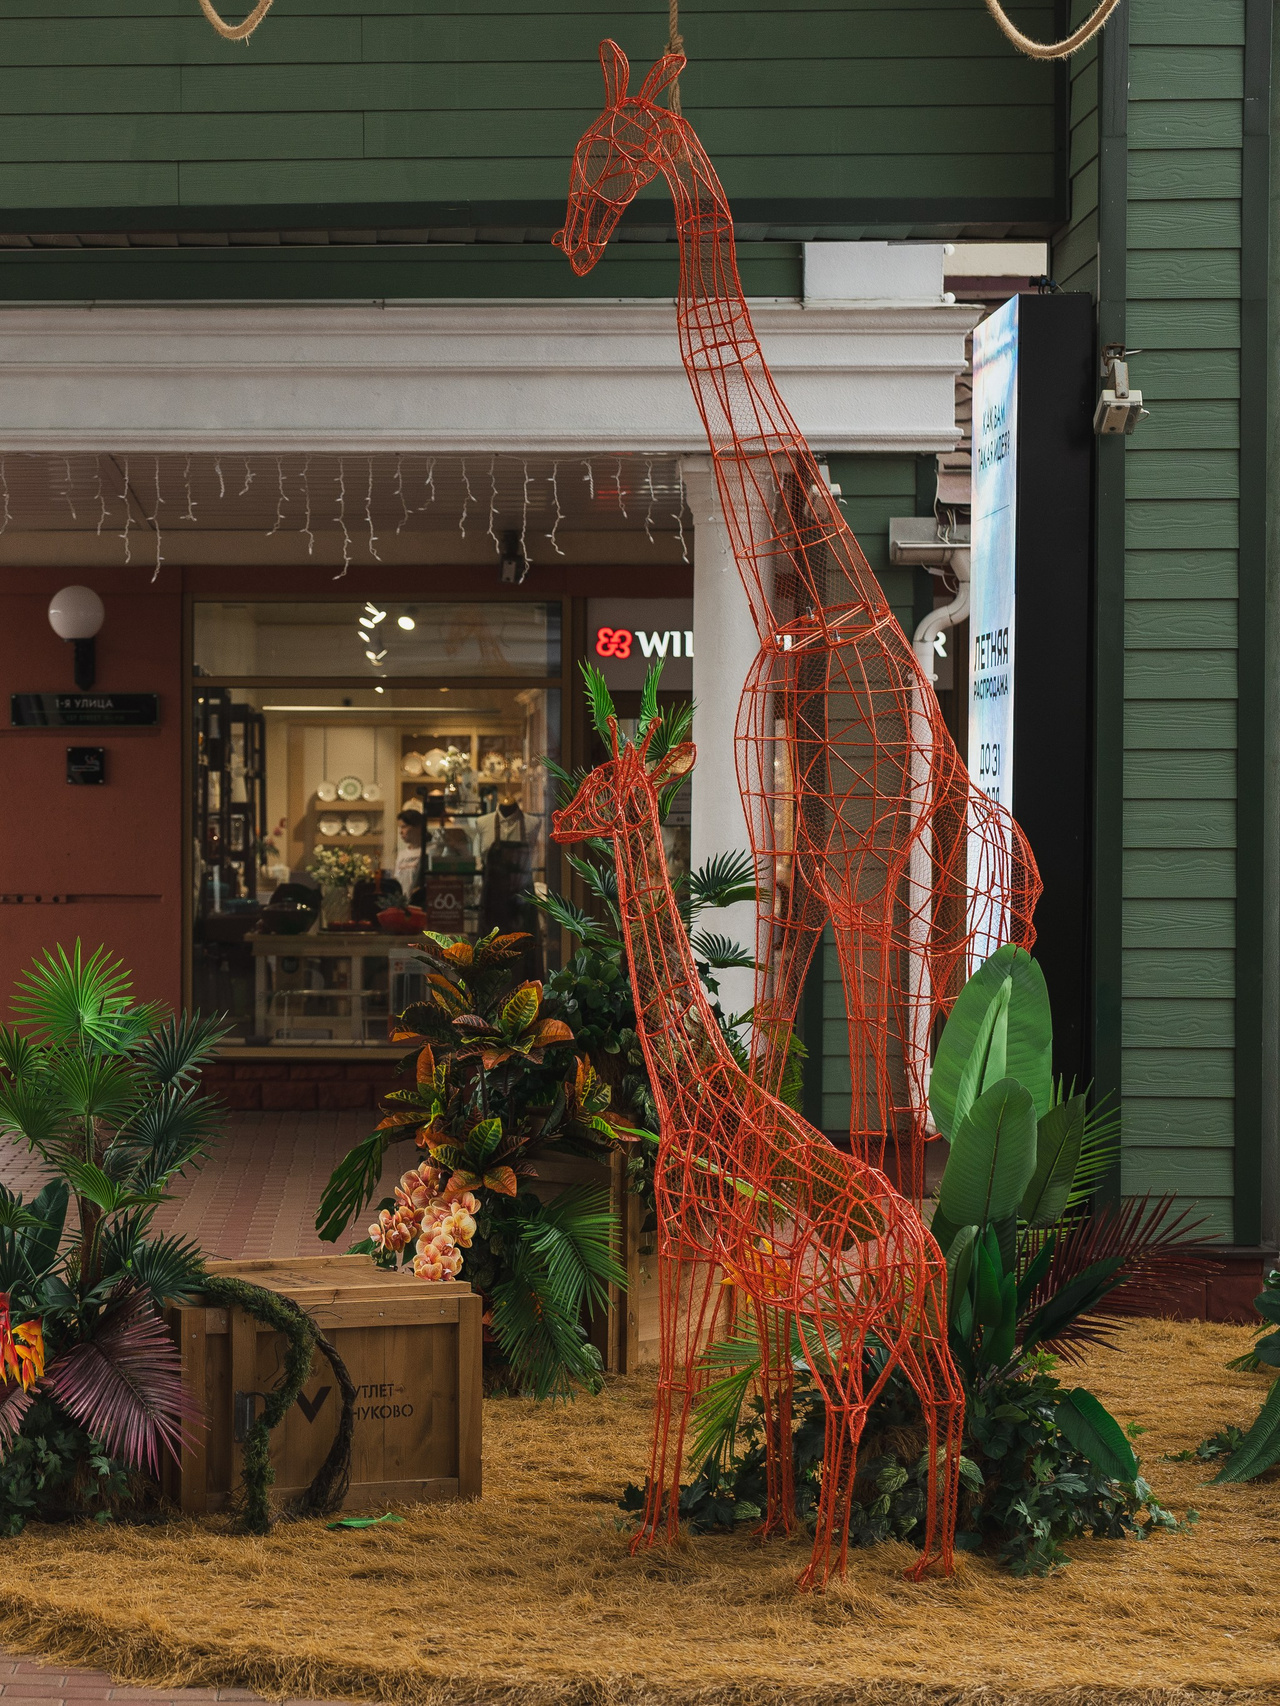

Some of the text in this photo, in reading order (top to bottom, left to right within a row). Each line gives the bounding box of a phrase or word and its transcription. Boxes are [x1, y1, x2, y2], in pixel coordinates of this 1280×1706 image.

[982, 402, 1006, 436] КАК ВАМ
[978, 430, 1010, 472] ТАКАЯ ИДЕЯ?
[974, 627, 1009, 672] ЛЕТНЯЯ
[55, 698, 115, 710] 1-Я УЛИЦА
[974, 674, 1009, 701] РАСПРОДАЖА
[979, 743, 1001, 781] ДО 31
[352, 1404, 414, 1420] НУКОВО
